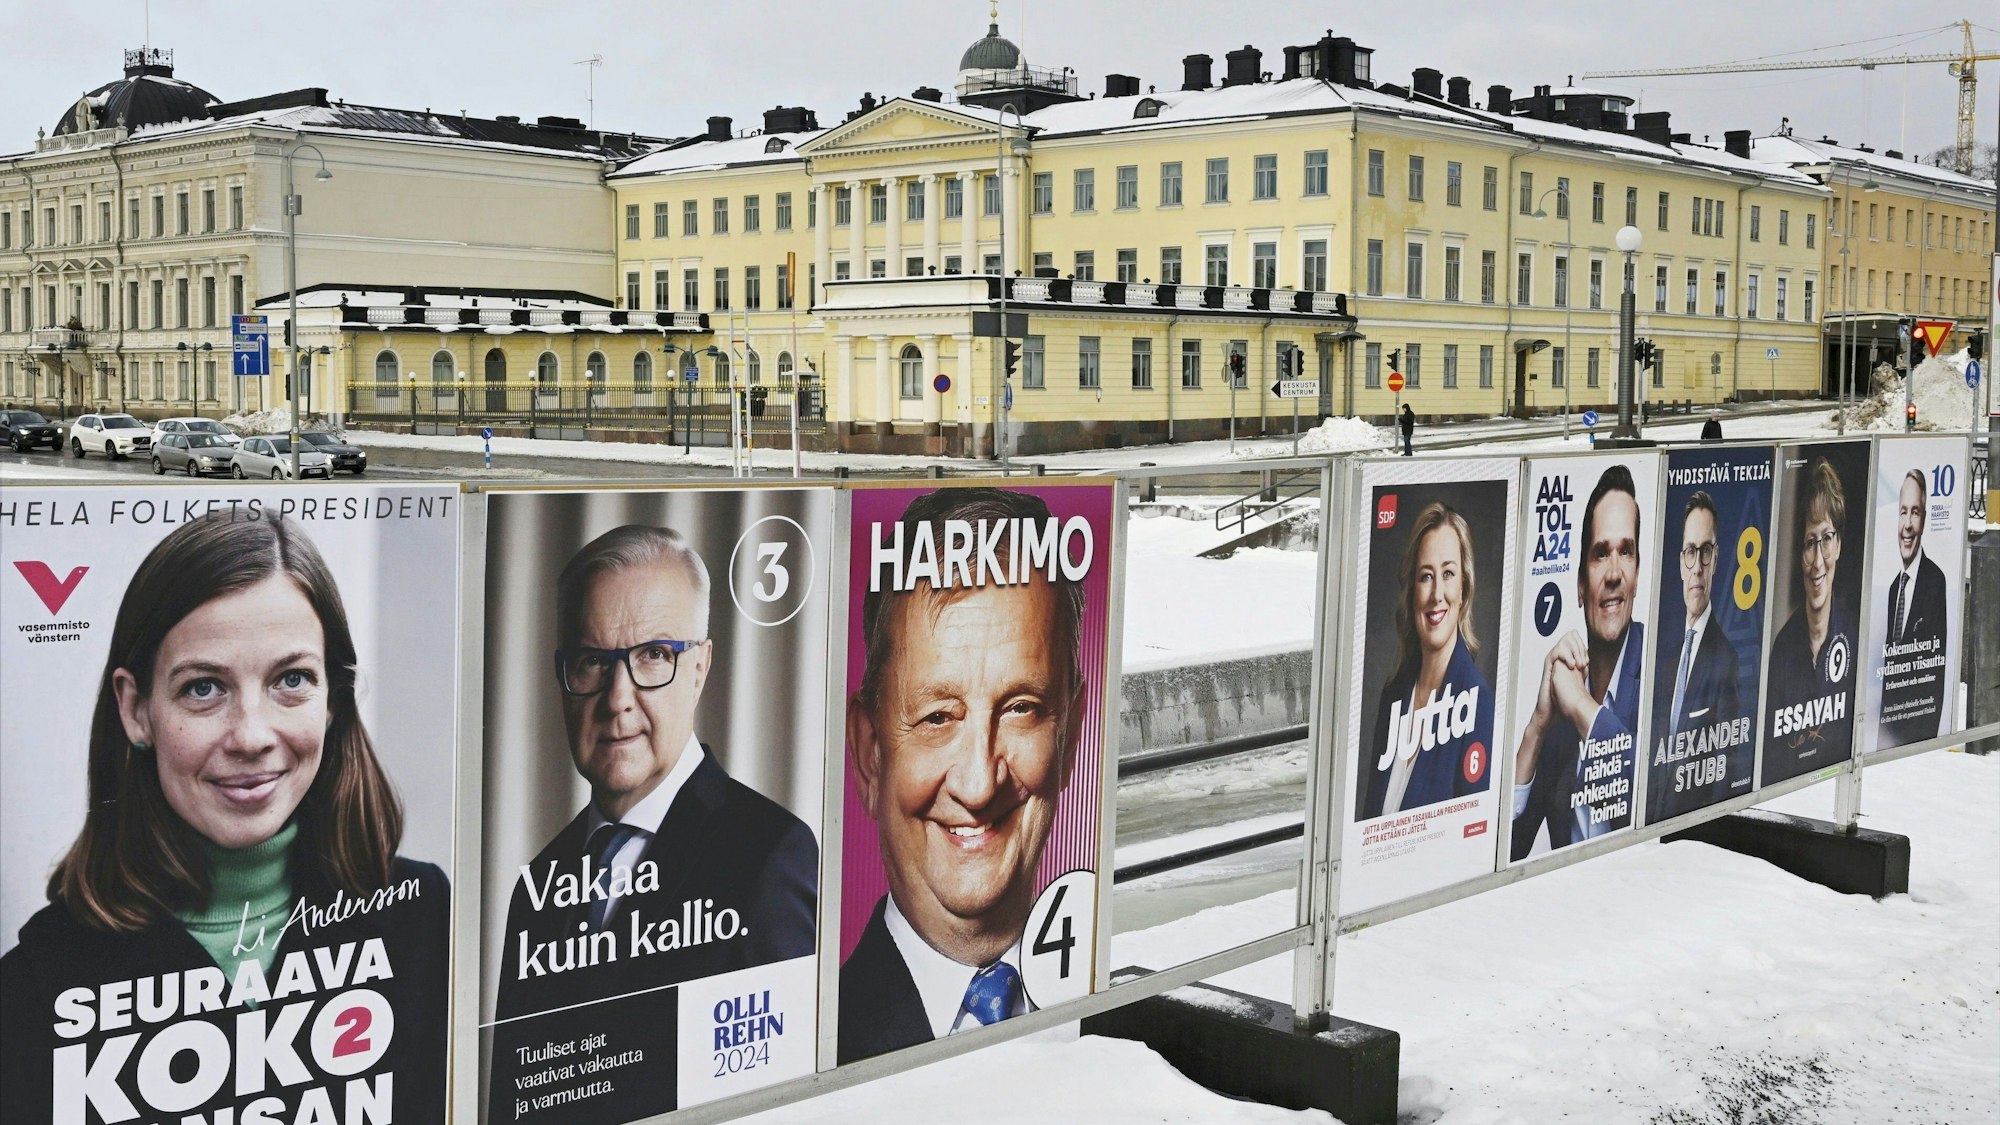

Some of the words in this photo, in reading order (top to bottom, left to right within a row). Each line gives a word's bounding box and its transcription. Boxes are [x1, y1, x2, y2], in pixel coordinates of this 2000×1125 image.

[1536, 475, 1573, 504] AAL
[1668, 463, 1730, 486] YHDISTÄVÄ
[1733, 460, 1771, 482] TEKIJÄ
[1931, 464, 1955, 497] 10
[0, 501, 90, 526] HELA
[110, 499, 262, 524] FOLKETS
[280, 496, 453, 520] PRESIDENT
[1379, 511, 1395, 524] SDP
[1536, 504, 1572, 533] TOL
[870, 515, 1094, 593] HARKIMO
[1533, 532, 1570, 563] A24
[752, 541, 790, 602] 3
[1733, 526, 1762, 611] 8
[18, 620, 90, 632] vasemmisto
[1543, 595, 1555, 624] 7
[28, 633, 80, 643] vänstern
[1882, 638, 1931, 658] Kokemuksen
[1932, 635, 1940, 652] ja
[1834, 648, 1843, 676] 9
[1876, 661, 1911, 680] sydämen
[1913, 655, 1945, 670] viisautta
[1377, 682, 1480, 772] Jutta
[1773, 692, 1847, 738] ESSAYAH
[1579, 733, 1632, 761] Viisautta
[1654, 717, 1751, 767] ALEXANDER
[1469, 750, 1479, 775] 6
[1584, 754, 1622, 782] nähdä
[1674, 754, 1727, 793] STUBB
[1570, 777, 1629, 809] rohkeutta
[1363, 824, 1380, 835] JUTTA
[1381, 816, 1411, 830] URPILAINEN
[1412, 808, 1444, 822] TASAVALLAN
[1590, 798, 1627, 825] toimia
[1362, 835, 1379, 846] JOTTA
[1380, 829, 1402, 841] KETÄÄN
[1402, 827, 1407, 836] EI
[519, 854, 660, 912] Vakaa
[232, 901, 266, 956] Li
[272, 878, 421, 951] Andersson
[1032, 884, 1076, 980] 4
[518, 921, 618, 980] kuin
[630, 898, 749, 958] kallio.
[53, 937, 394, 1039] SEURAAVA
[713, 990, 770, 1024] OLLI
[332, 1006, 373, 1058] 2
[713, 1012, 784, 1051] REHN
[516, 1040, 576, 1066] Tuuliset
[580, 1033, 607, 1055] ajat
[713, 1042, 770, 1077] 2024
[515, 1063, 575, 1090] vaativat
[578, 1048, 643, 1075] vakautta
[514, 1099, 529, 1120] ja
[532, 1078, 614, 1111] varmuutta.
